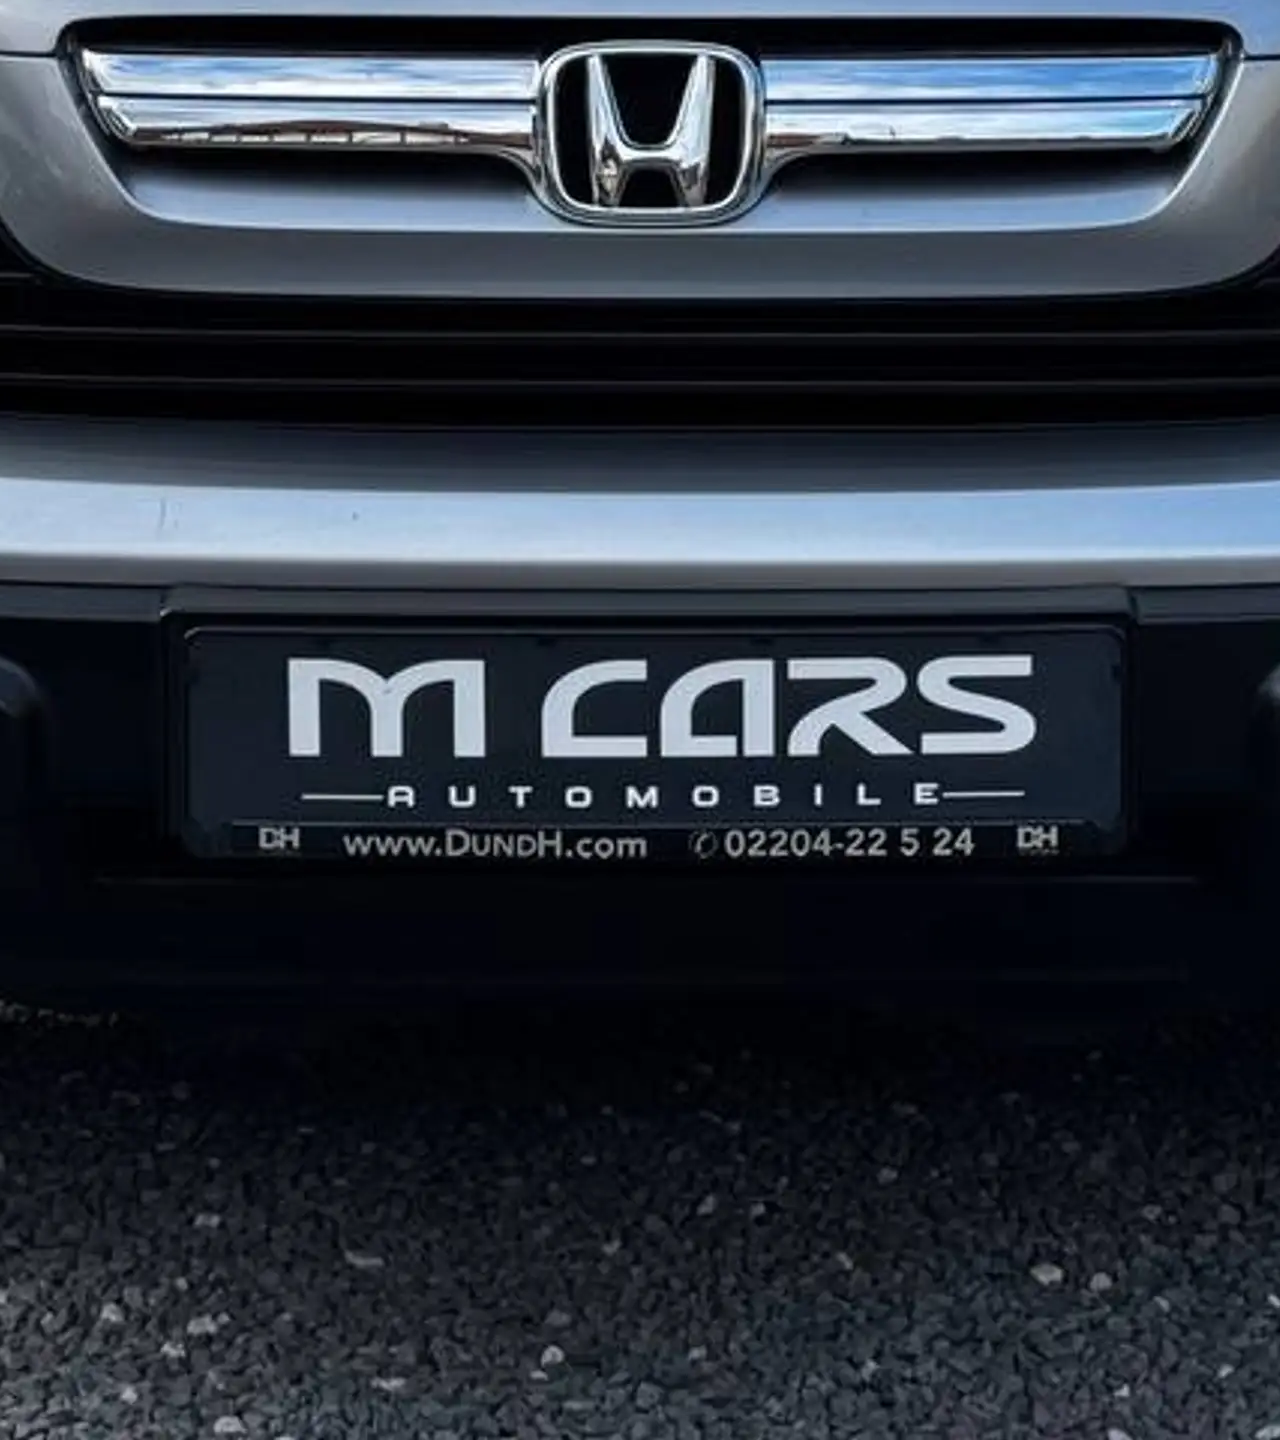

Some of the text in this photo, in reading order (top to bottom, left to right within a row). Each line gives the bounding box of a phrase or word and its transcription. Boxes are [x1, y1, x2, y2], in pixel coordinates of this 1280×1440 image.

[288, 654, 1037, 758] M CARS
[387, 782, 940, 808] AUTOMOBILE
[258, 826, 301, 850] DH
[724, 826, 975, 857] 02204-22 5 24
[1016, 824, 1059, 848] DH
